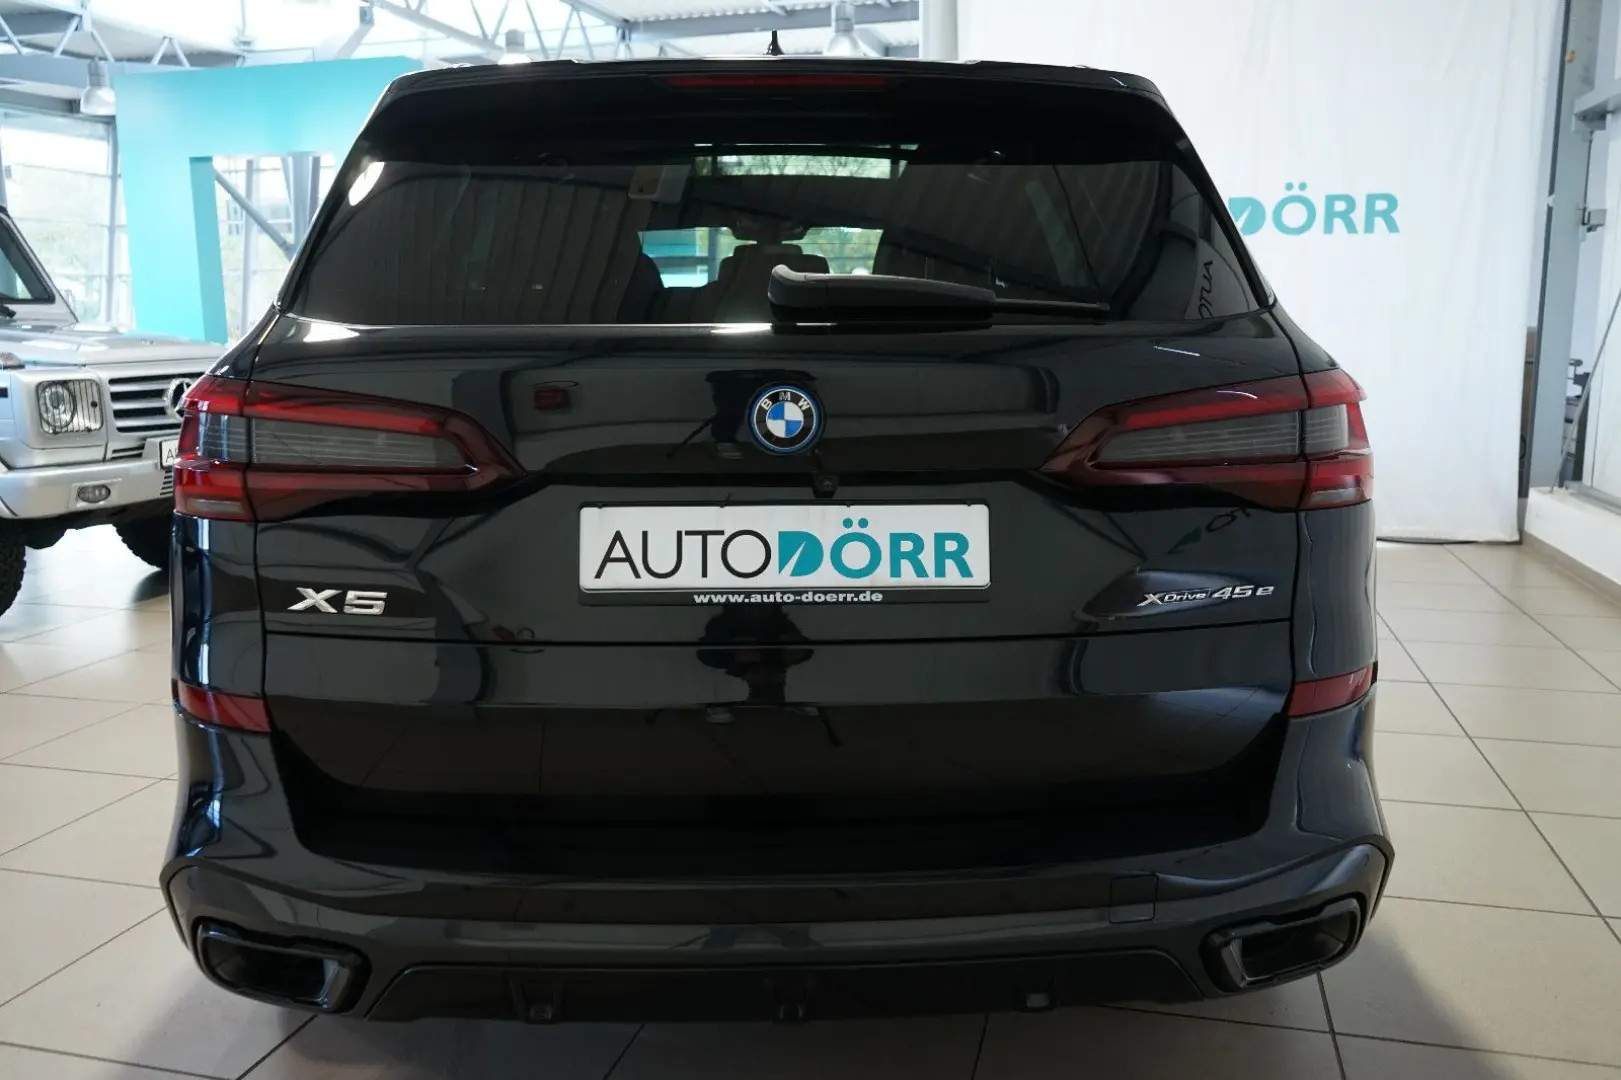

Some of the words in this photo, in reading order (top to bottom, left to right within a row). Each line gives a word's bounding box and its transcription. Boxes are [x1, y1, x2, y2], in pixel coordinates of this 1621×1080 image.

[761, 392, 810, 410] BMW
[287, 587, 388, 615] X5
[693, 590, 883, 604] www.auto-doerr.de
